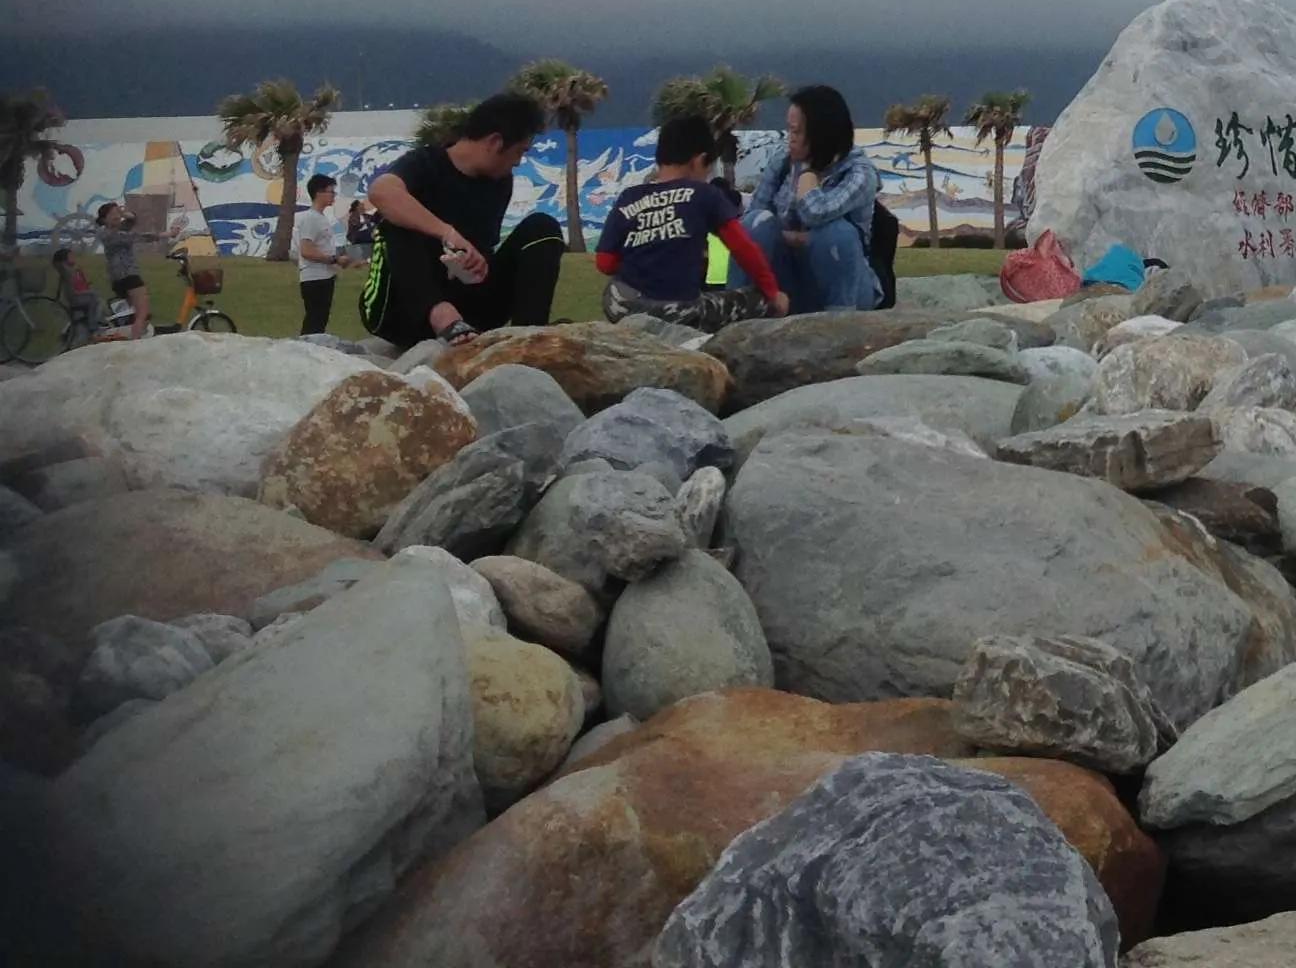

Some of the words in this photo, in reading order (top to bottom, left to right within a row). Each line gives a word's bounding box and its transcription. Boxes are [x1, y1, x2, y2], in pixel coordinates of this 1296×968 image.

[619, 187, 695, 220] YOUNGSTER
[637, 205, 676, 230] STAYS
[1232, 189, 1295, 222] 經濟部
[1238, 228, 1296, 259] 水利署
